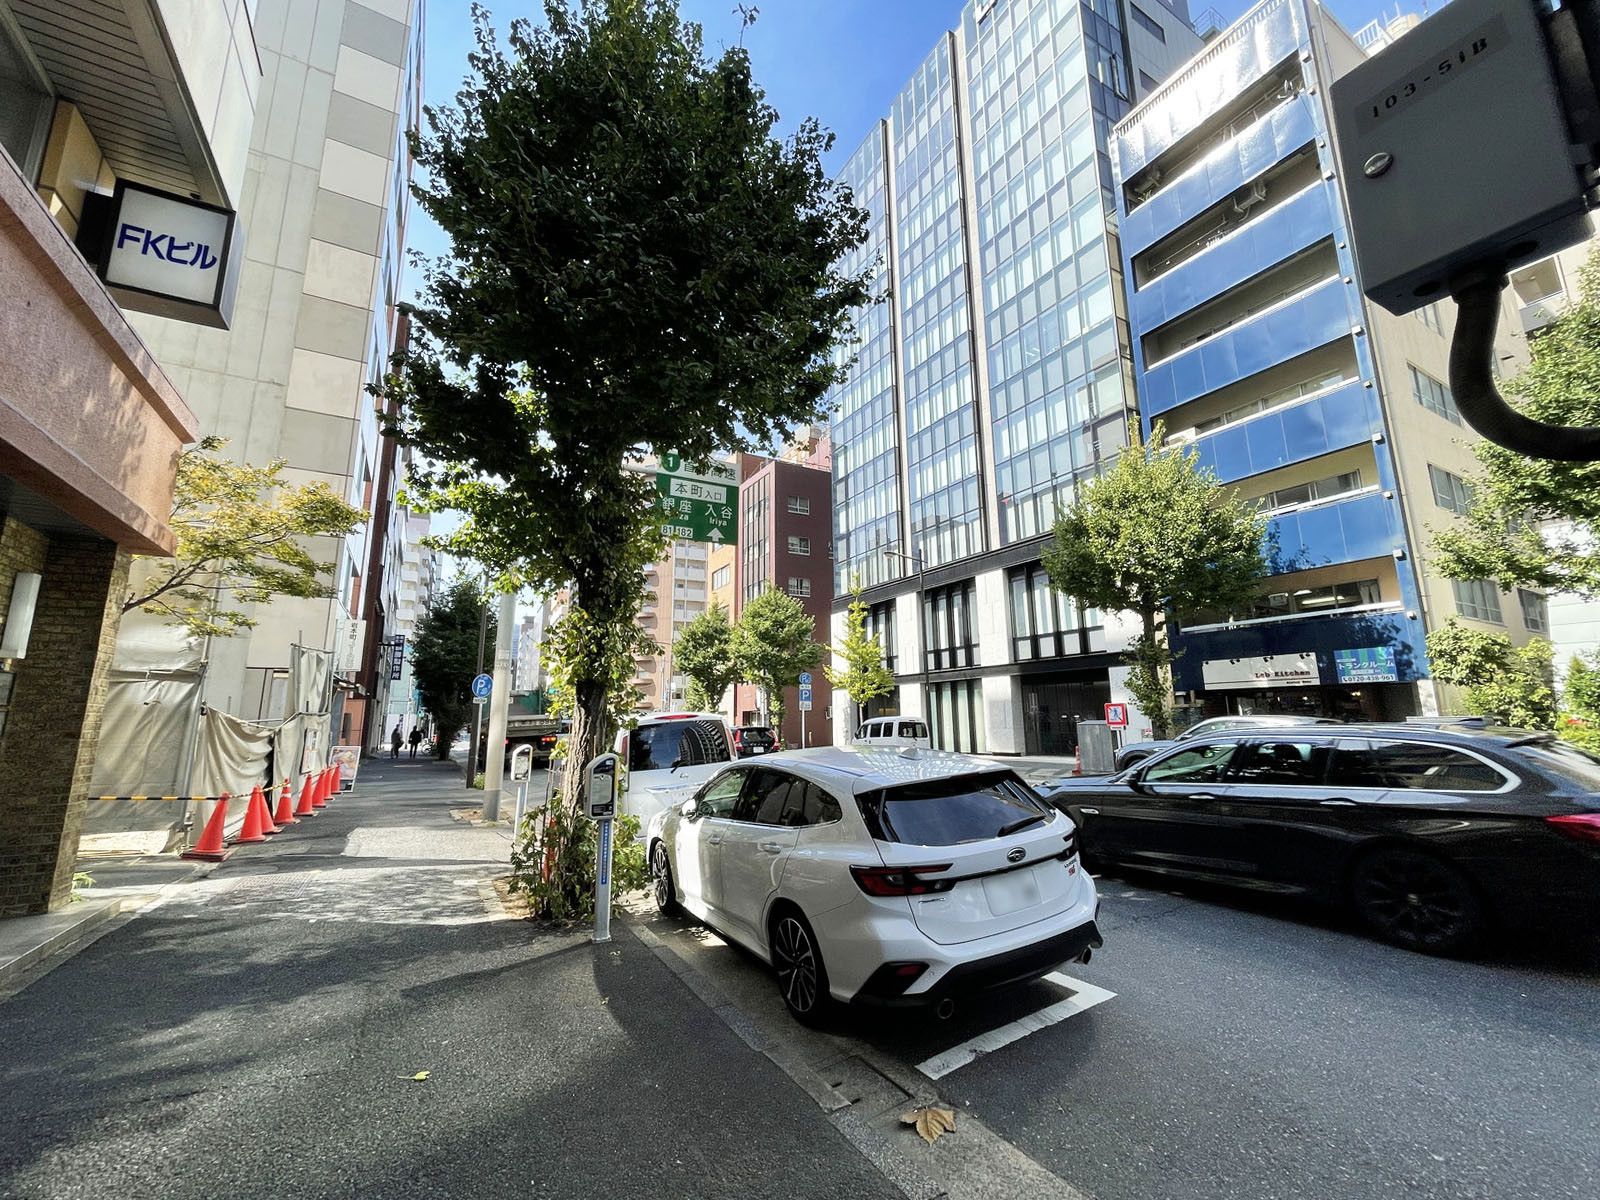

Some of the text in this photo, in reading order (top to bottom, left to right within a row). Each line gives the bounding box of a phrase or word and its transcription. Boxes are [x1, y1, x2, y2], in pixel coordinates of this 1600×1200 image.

[117, 223, 217, 269] FKビル
[675, 481, 722, 501] 本町入口
[662, 497, 692, 513] 銀座
[704, 503, 733, 520] 入谷
[709, 517, 728, 527] Iriya
